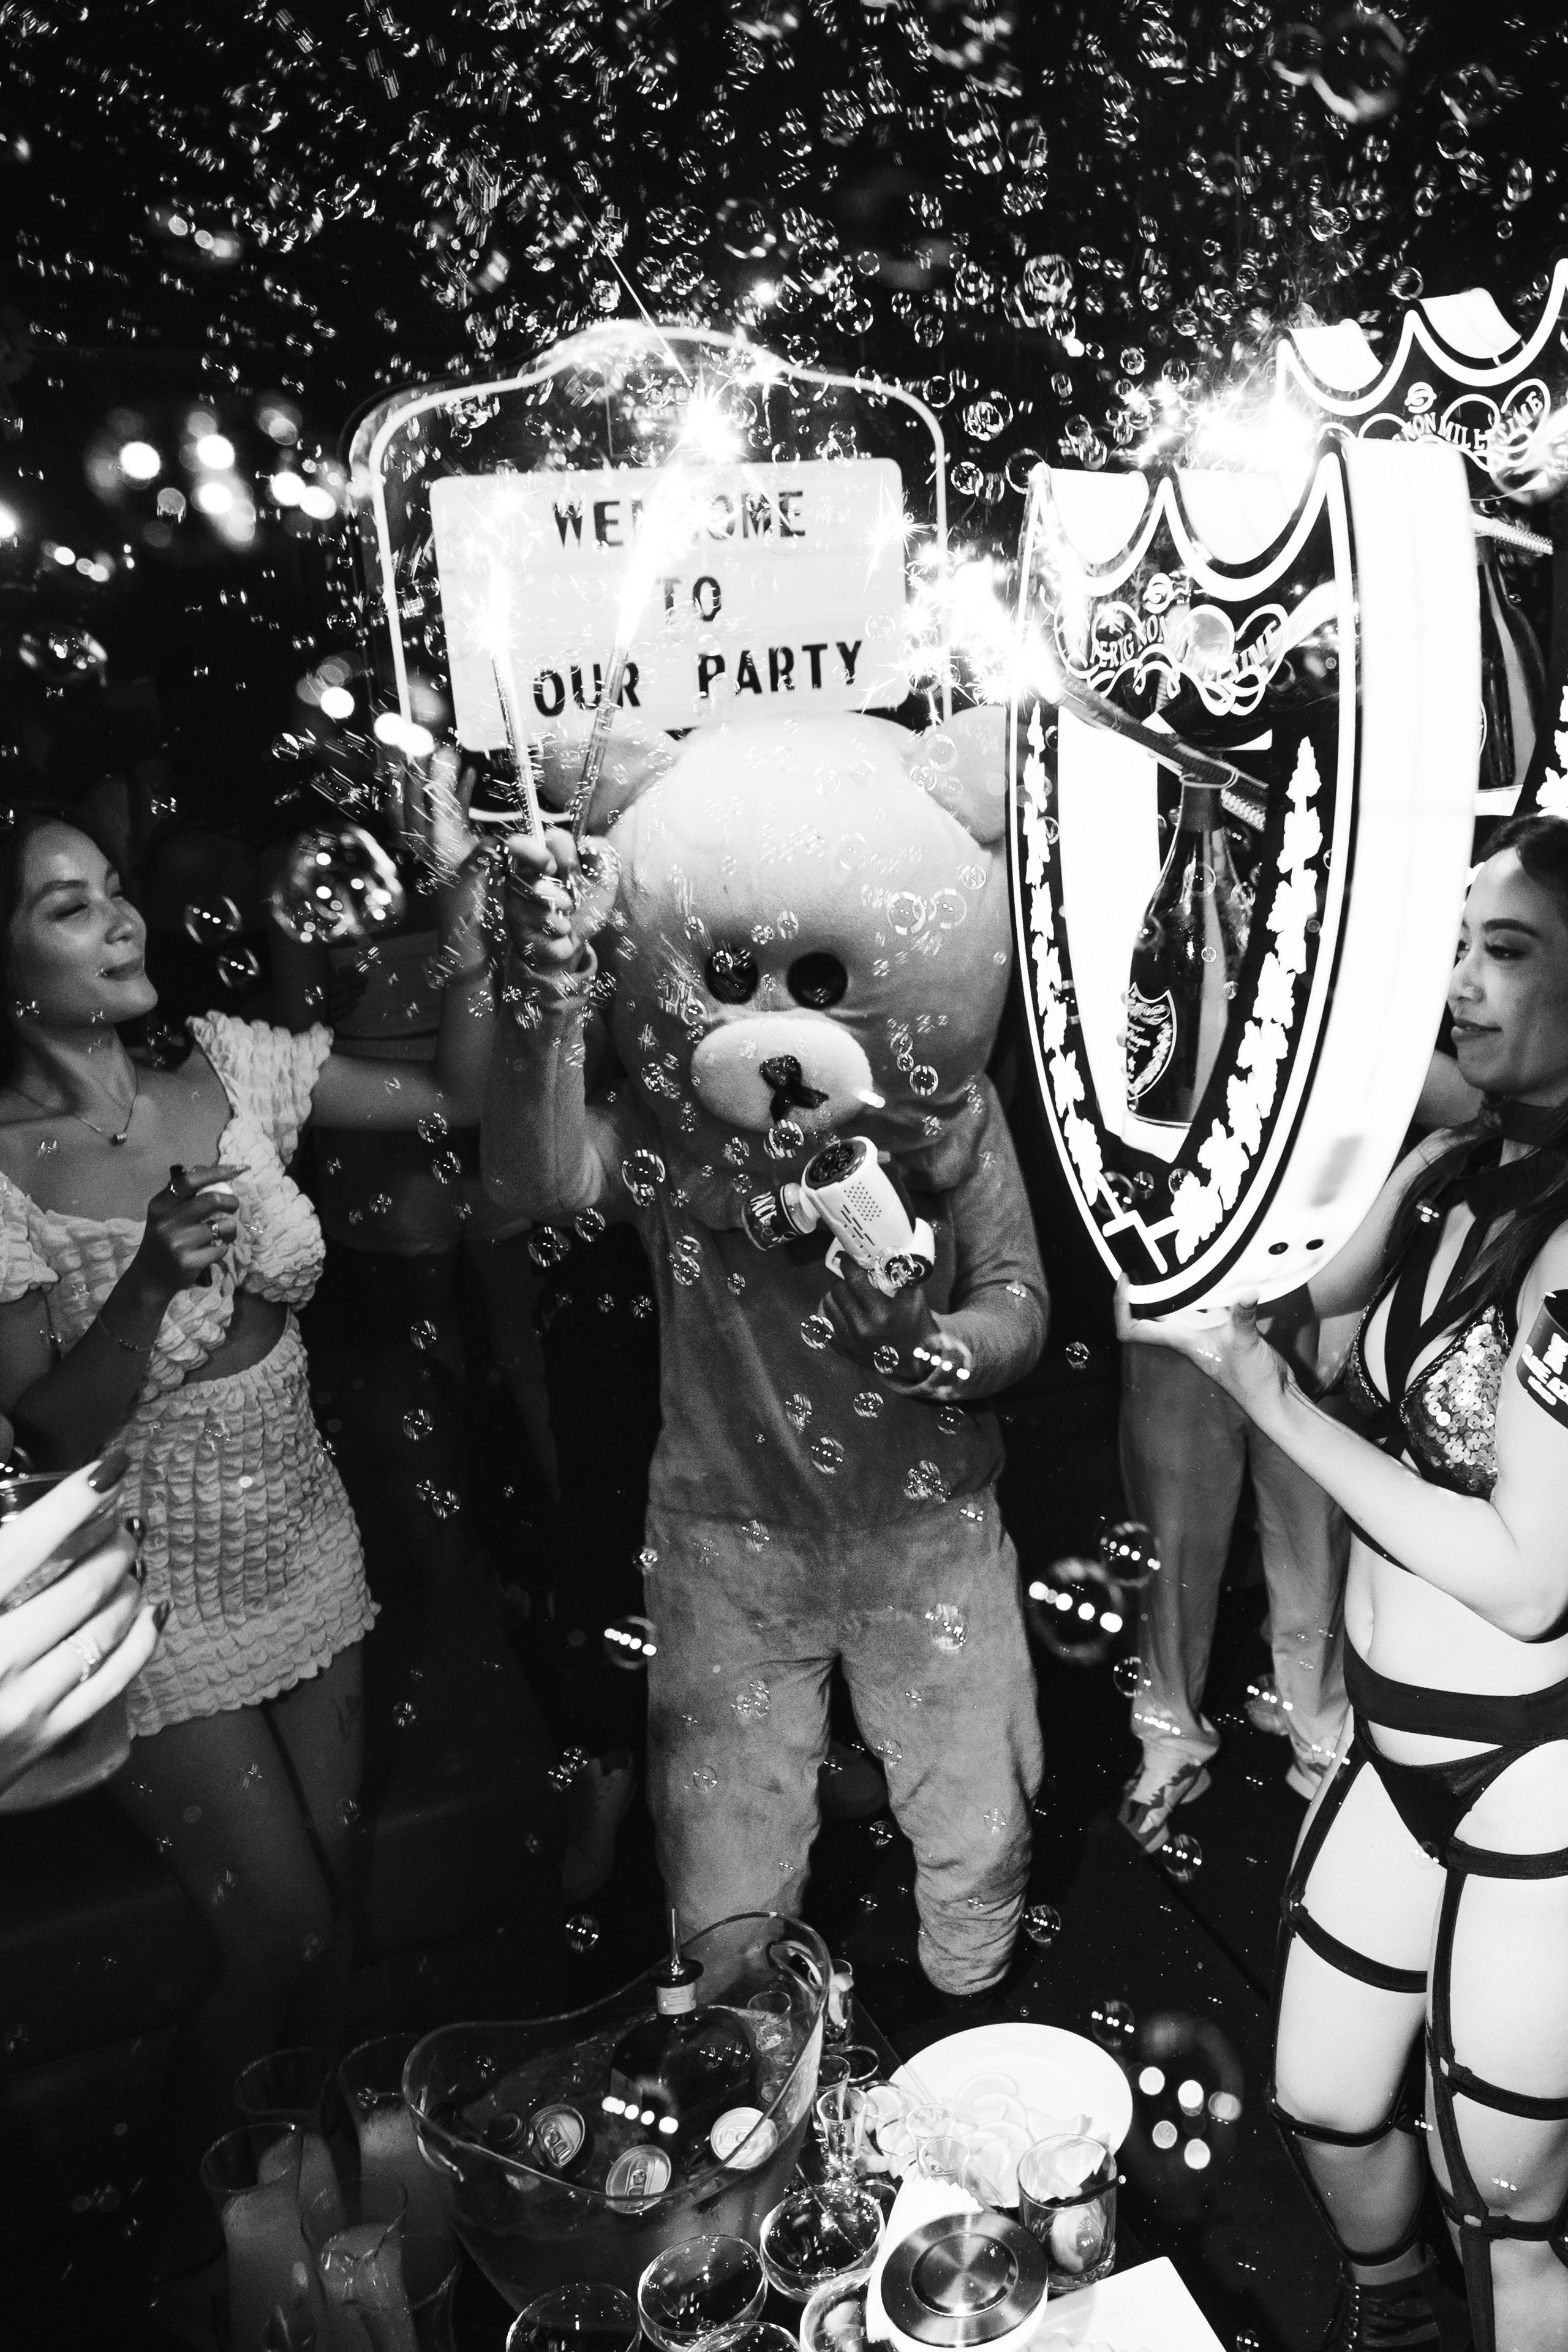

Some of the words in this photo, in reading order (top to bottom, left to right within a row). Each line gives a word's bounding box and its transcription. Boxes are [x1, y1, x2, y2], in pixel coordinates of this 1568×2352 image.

[552, 490, 806, 549] WEOME
[655, 576, 722, 622] TO
[533, 662, 641, 717] OUR
[697, 640, 862, 699] PARTY
